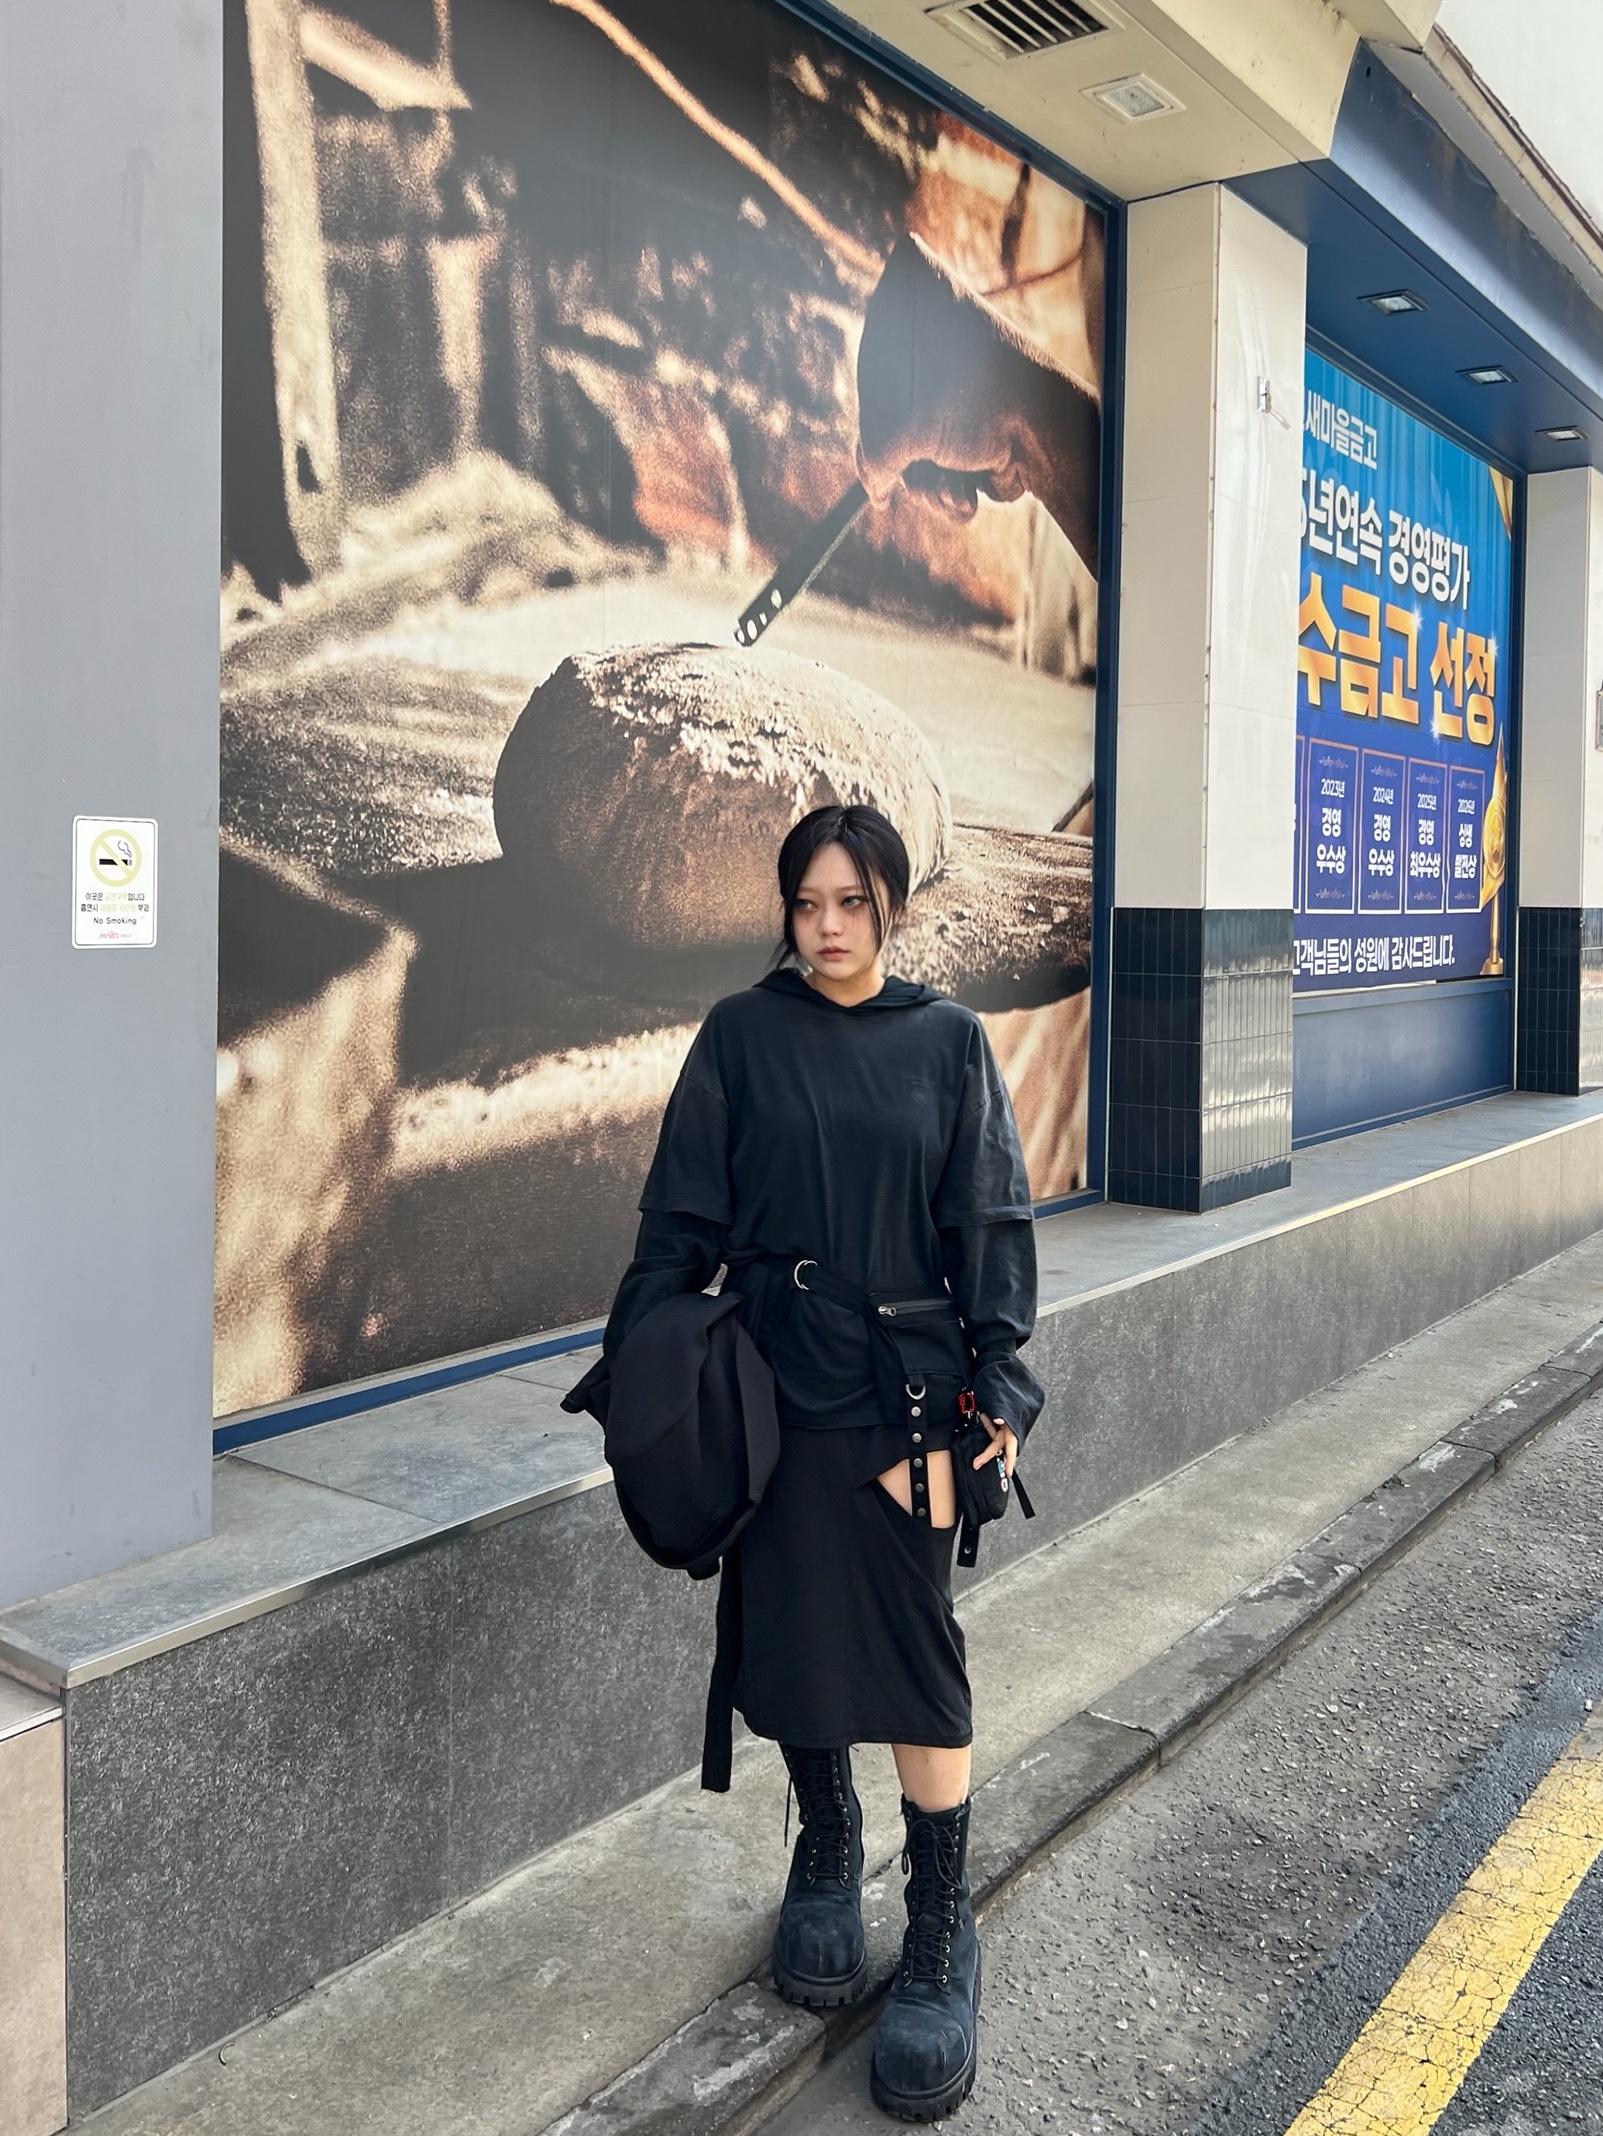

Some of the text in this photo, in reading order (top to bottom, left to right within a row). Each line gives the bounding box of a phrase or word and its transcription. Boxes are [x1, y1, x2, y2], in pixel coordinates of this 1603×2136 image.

[1306, 390, 1378, 470] 새마을금고
[1389, 509, 1471, 610] 경영평가
[1298, 571, 1496, 746] 수금고 선정
[1320, 778, 1346, 799] 2023년
[1372, 786, 1395, 805] 2024년
[1417, 793, 1437, 811] 2025년
[1322, 807, 1342, 838] 경영
[1373, 814, 1392, 842] 경영
[1418, 819, 1435, 846] 경영
[1458, 823, 1474, 849] 상생
[1316, 843, 1347, 875] 우수상
[1368, 848, 1396, 877] 우수상
[1410, 851, 1442, 879] 최우수상
[80, 903, 98, 913] 흡연시
[85, 892, 104, 902] 이곳은
[93, 917, 137, 926] No Smoking
[1354, 936, 1390, 974] 성원에
[1391, 933, 1456, 971] 감사드립니다.
